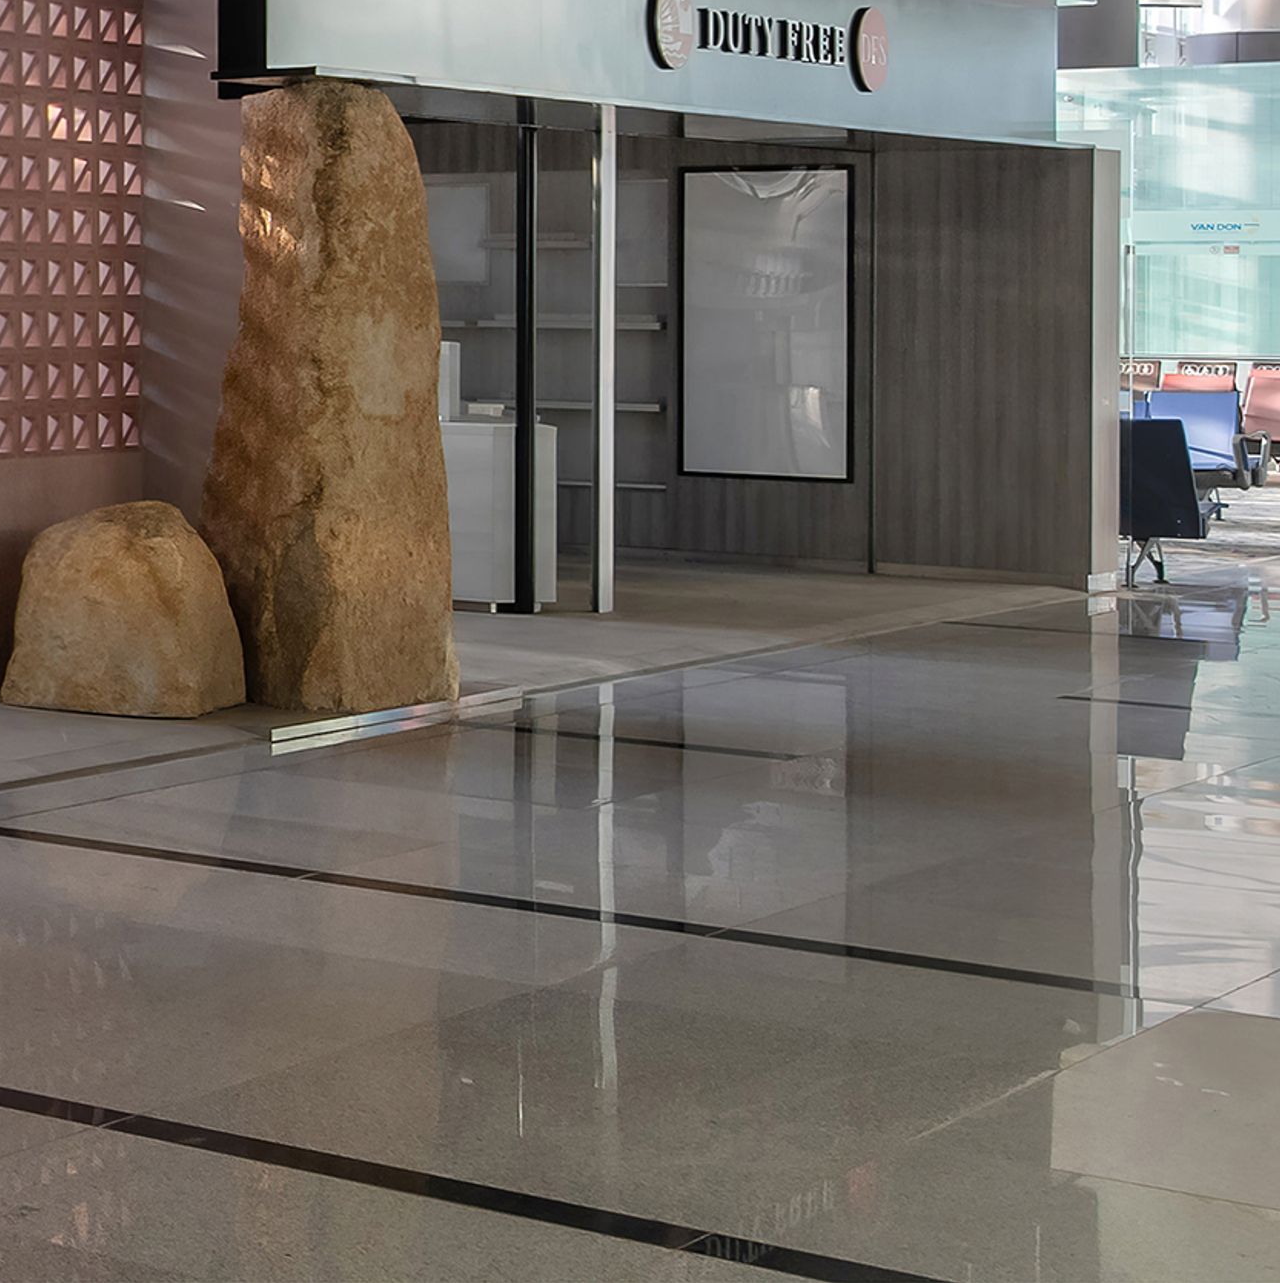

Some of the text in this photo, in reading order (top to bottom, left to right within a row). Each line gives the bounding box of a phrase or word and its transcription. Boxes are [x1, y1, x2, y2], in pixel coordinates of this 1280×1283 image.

[697, 7, 846, 66] DUTY FREE
[862, 32, 888, 67] DFS
